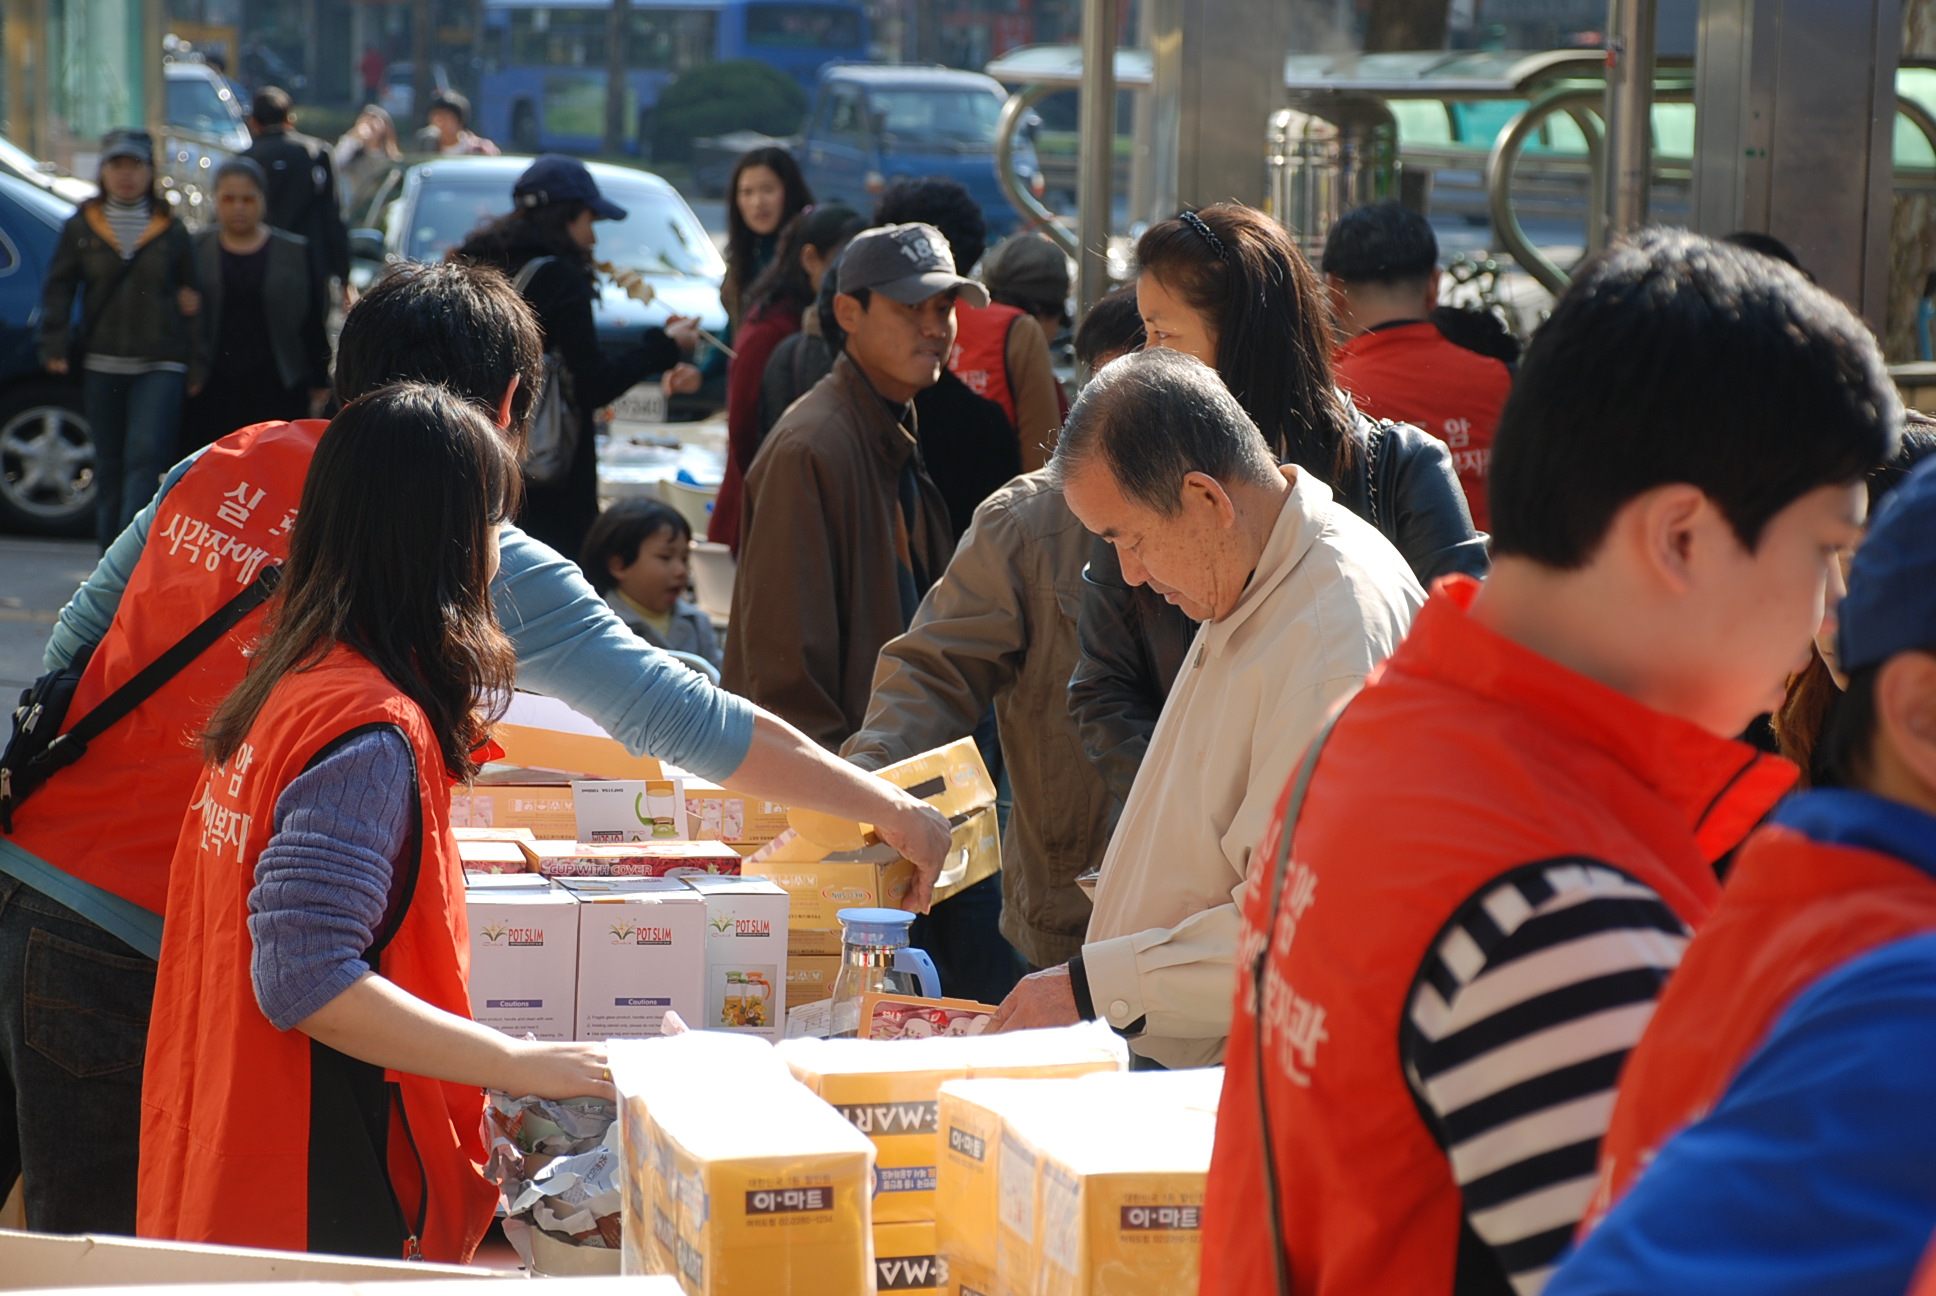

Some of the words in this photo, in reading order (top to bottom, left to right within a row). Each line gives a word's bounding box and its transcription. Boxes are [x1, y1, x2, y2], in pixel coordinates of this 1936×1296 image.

[1444, 417, 1472, 448] 암
[216, 481, 267, 530] 실
[160, 513, 284, 585] 시각장애
[228, 742, 254, 798] 암
[550, 865, 575, 875] CUP
[577, 864, 609, 875] WITH
[611, 864, 652, 875] COVER
[508, 929, 524, 942] POT
[525, 929, 544, 942] SLIM
[636, 927, 652, 941] POT
[653, 927, 672, 941] SLIM
[735, 920, 750, 933] POT
[751, 920, 770, 933] SLIM
